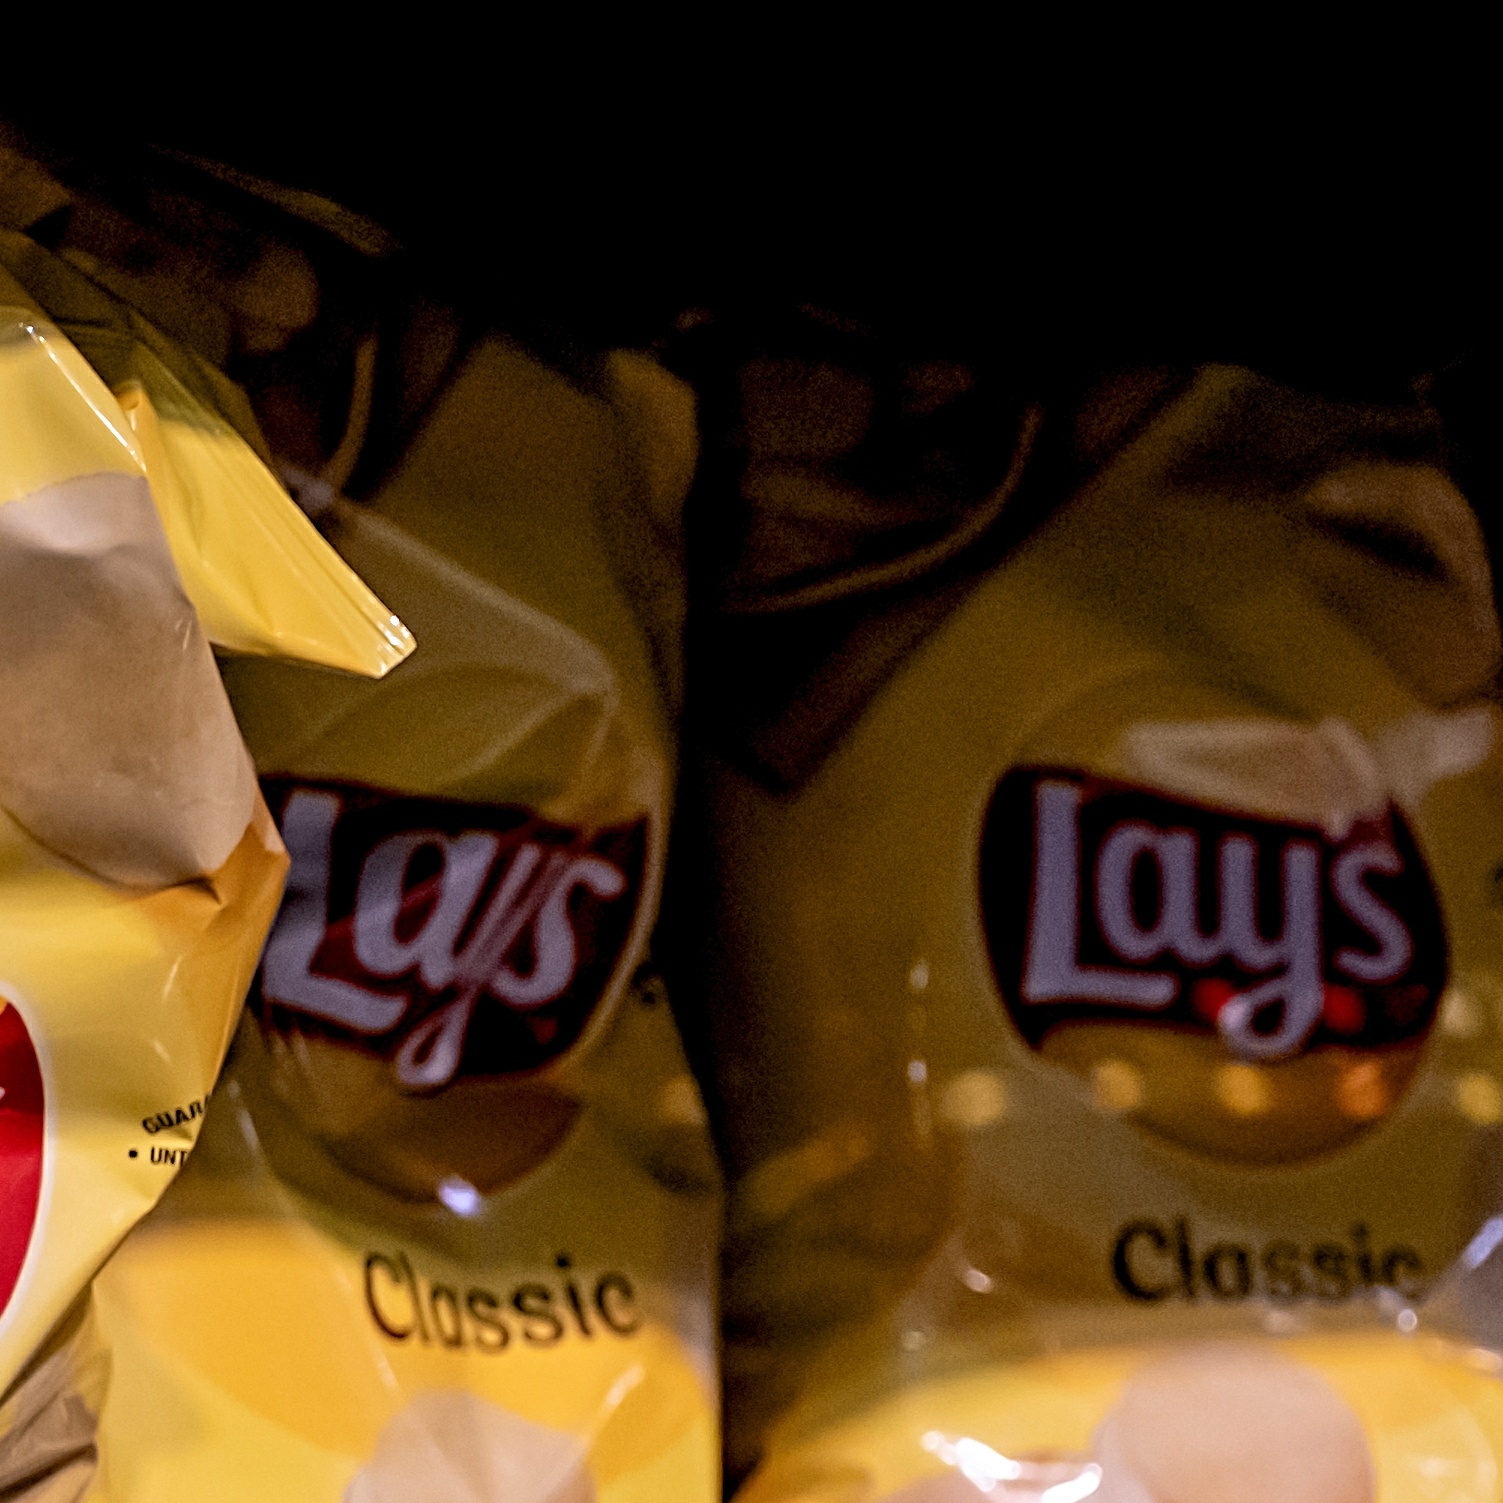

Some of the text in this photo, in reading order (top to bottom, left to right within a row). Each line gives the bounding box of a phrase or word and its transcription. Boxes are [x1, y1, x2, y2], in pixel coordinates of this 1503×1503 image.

[141, 1093, 212, 1134] GUAR
[366, 1253, 640, 1352] Classic
[1110, 1213, 1424, 1308] Classic
